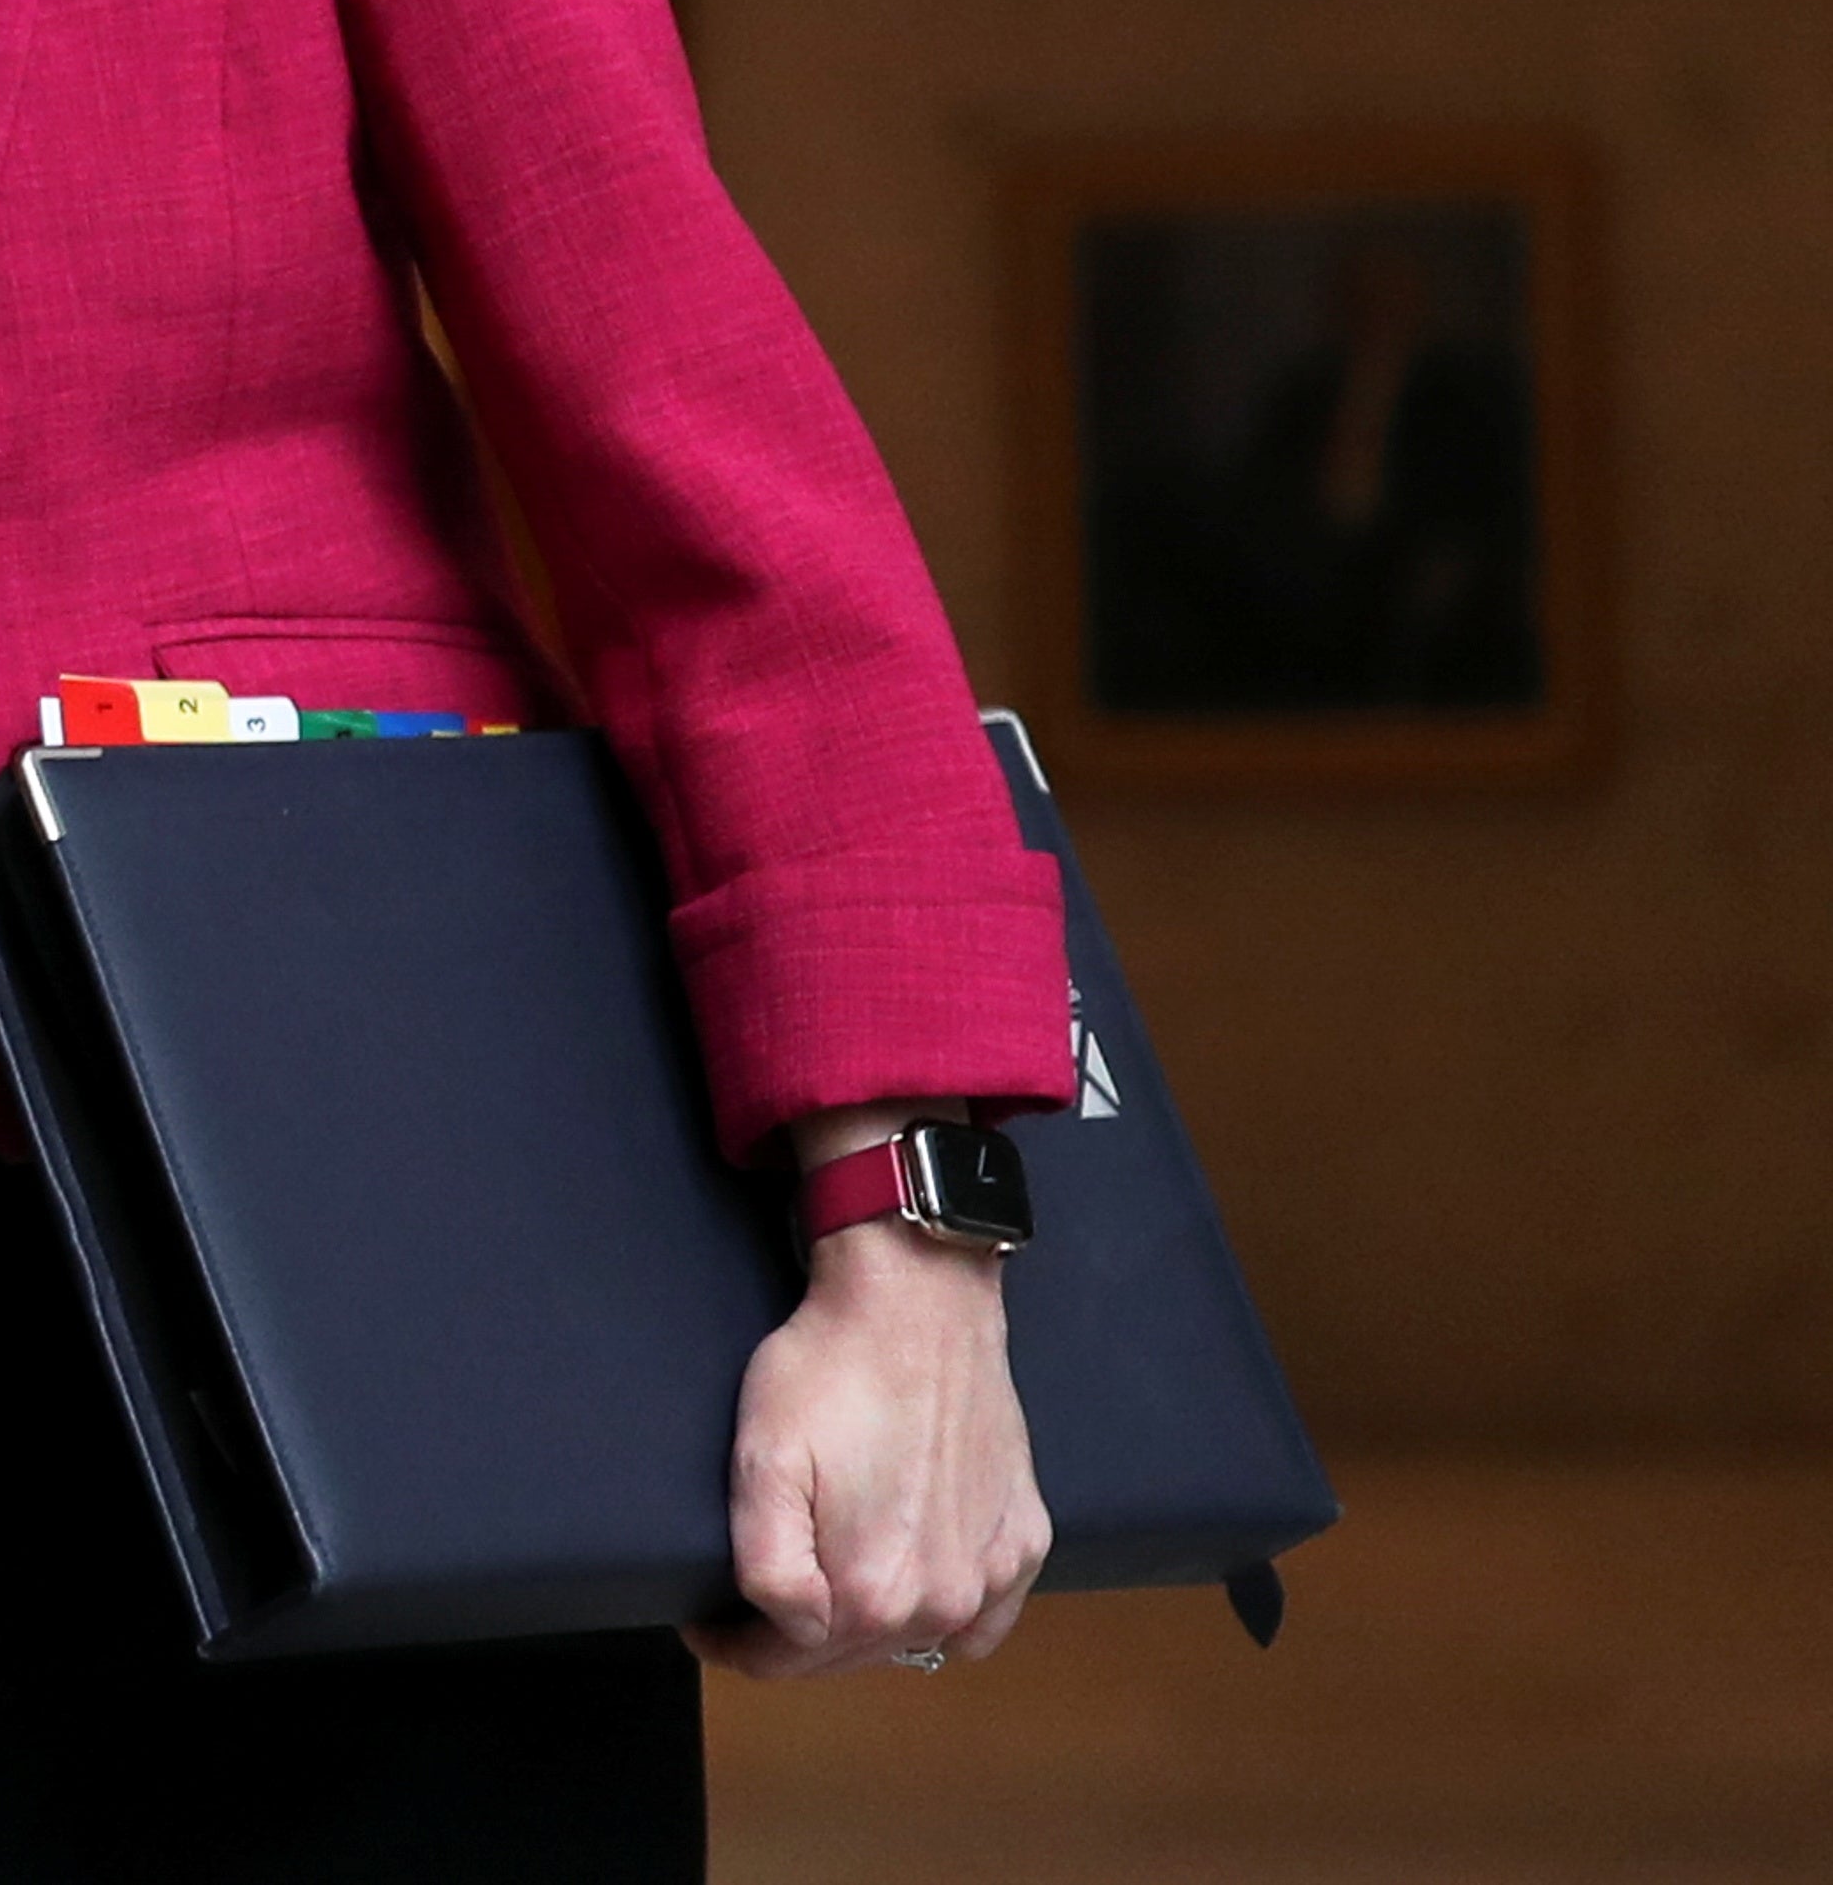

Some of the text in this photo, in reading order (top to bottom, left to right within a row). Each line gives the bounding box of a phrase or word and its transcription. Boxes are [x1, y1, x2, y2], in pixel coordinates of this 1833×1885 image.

[97, 703, 113, 713] 1
[179, 698, 198, 714] 2
[247, 717, 266, 733] 3
